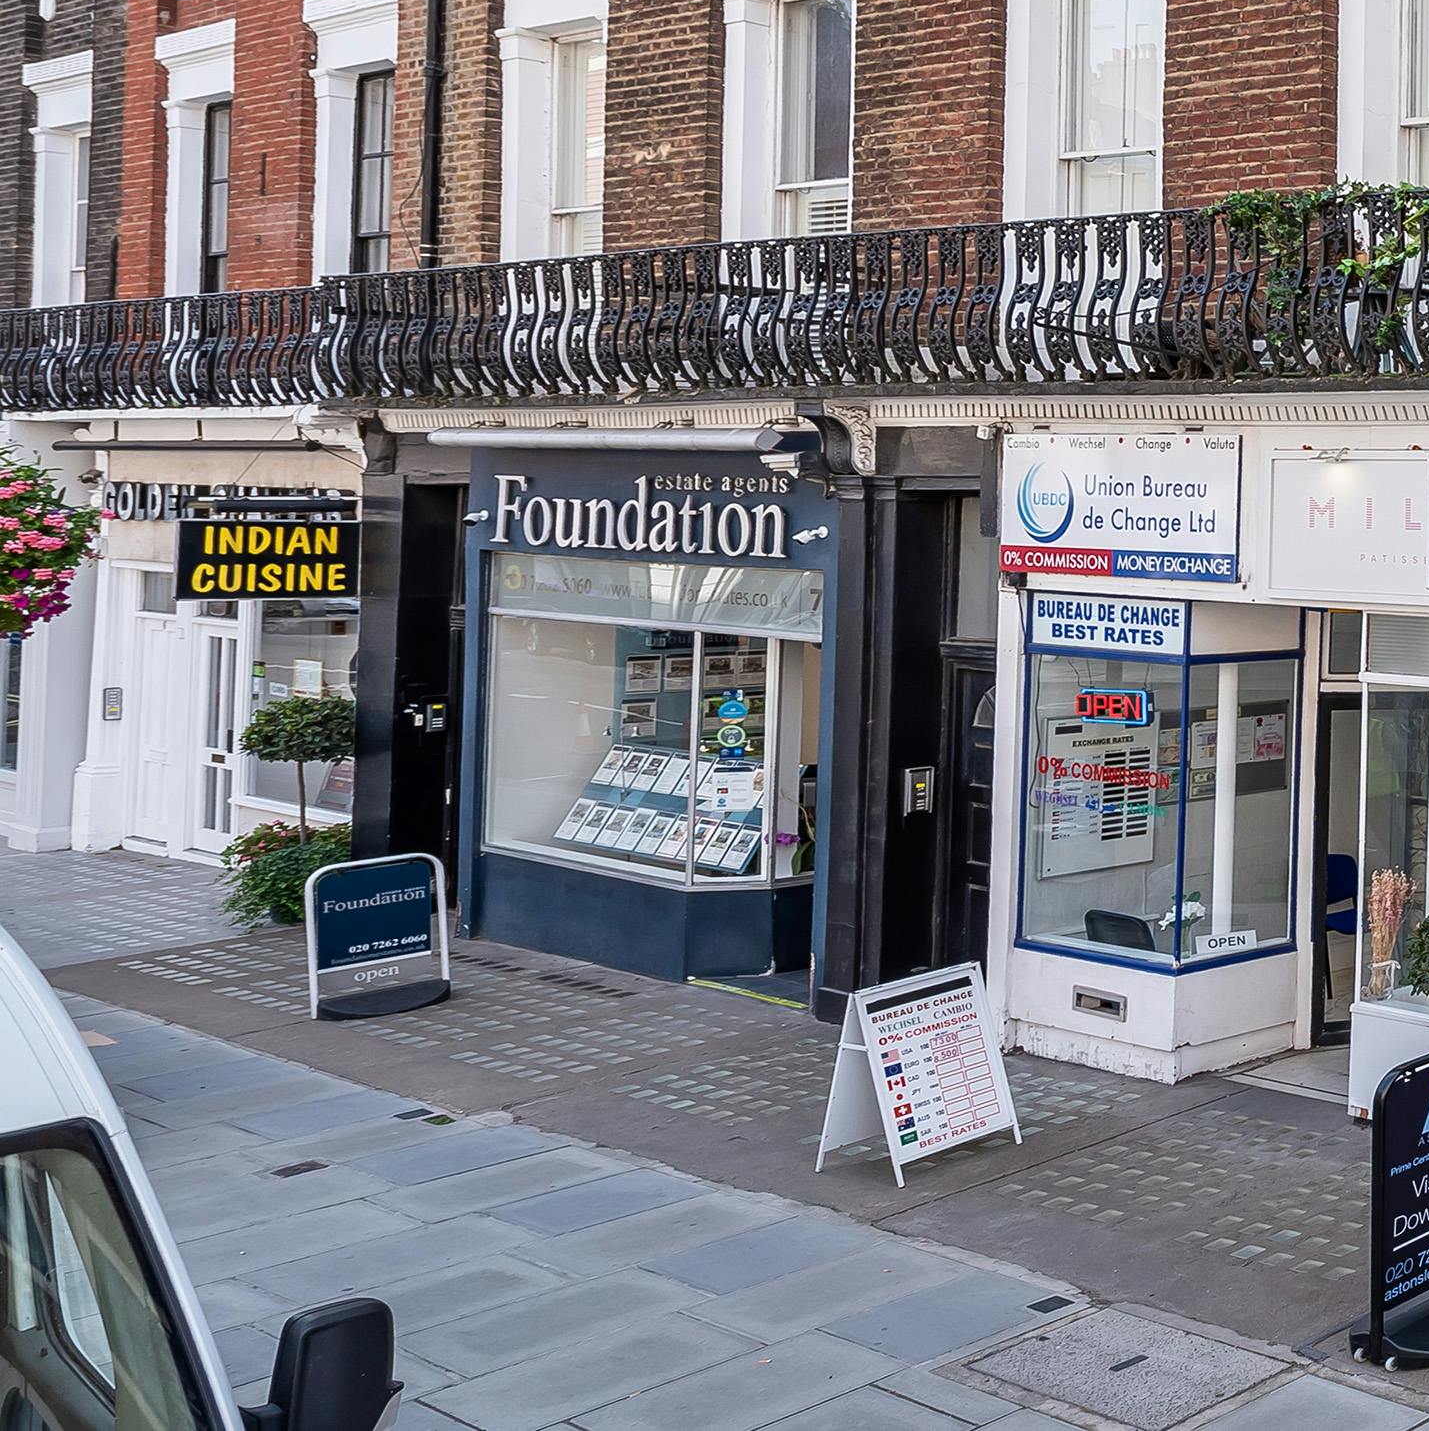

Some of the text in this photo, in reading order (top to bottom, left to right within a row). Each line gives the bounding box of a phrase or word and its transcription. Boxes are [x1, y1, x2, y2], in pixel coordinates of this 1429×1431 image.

[1007, 437, 1236, 452] Cambio Wechsel Change Valuta
[654, 472, 791, 497] estate agents
[1084, 474, 1208, 498] Union Bureau
[1032, 492, 1067, 506] UBDC
[489, 474, 788, 558] Foundation
[1082, 506, 1216, 539] de Change Ltd
[204, 525, 339, 556] INDIAN
[1003, 552, 1232, 576] 0% COMMISSION MONEY EXCHANGE
[191, 563, 347, 593] CUISINE
[1037, 599, 1180, 628] BUREAU DE CHANGE
[1051, 623, 1165, 647] BEST RATES
[1075, 694, 1141, 720] OPEN
[1072, 736, 1134, 748] EXCHANGE RATES
[1038, 756, 1170, 790] 0% COMMISSION
[323, 889, 426, 913] Foundation
[349, 934, 428, 953] 020 7262 6060
[1207, 935, 1246, 949] OPEN
[354, 966, 400, 983] open
[871, 990, 974, 1024] BUREAU DE CHANGE
[877, 1016, 924, 1035] WECHSEL
[933, 1002, 973, 1020] CAMBIO
[878, 1034, 903, 1046] 0%
[905, 1012, 978, 1039] COMMISSION
[902, 1042, 930, 1056] USA 100
[904, 1056, 933, 1069] EURO 100
[907, 1069, 936, 1083] CAD 100
[932, 1095, 942, 1103] 100
[936, 1109, 945, 1117] 100
[919, 1120, 988, 1149] BEST RATES
[938, 1122, 948, 1130] 100
[1390, 1161, 1412, 1177] Prime
[1385, 1257, 1414, 1285] 020
